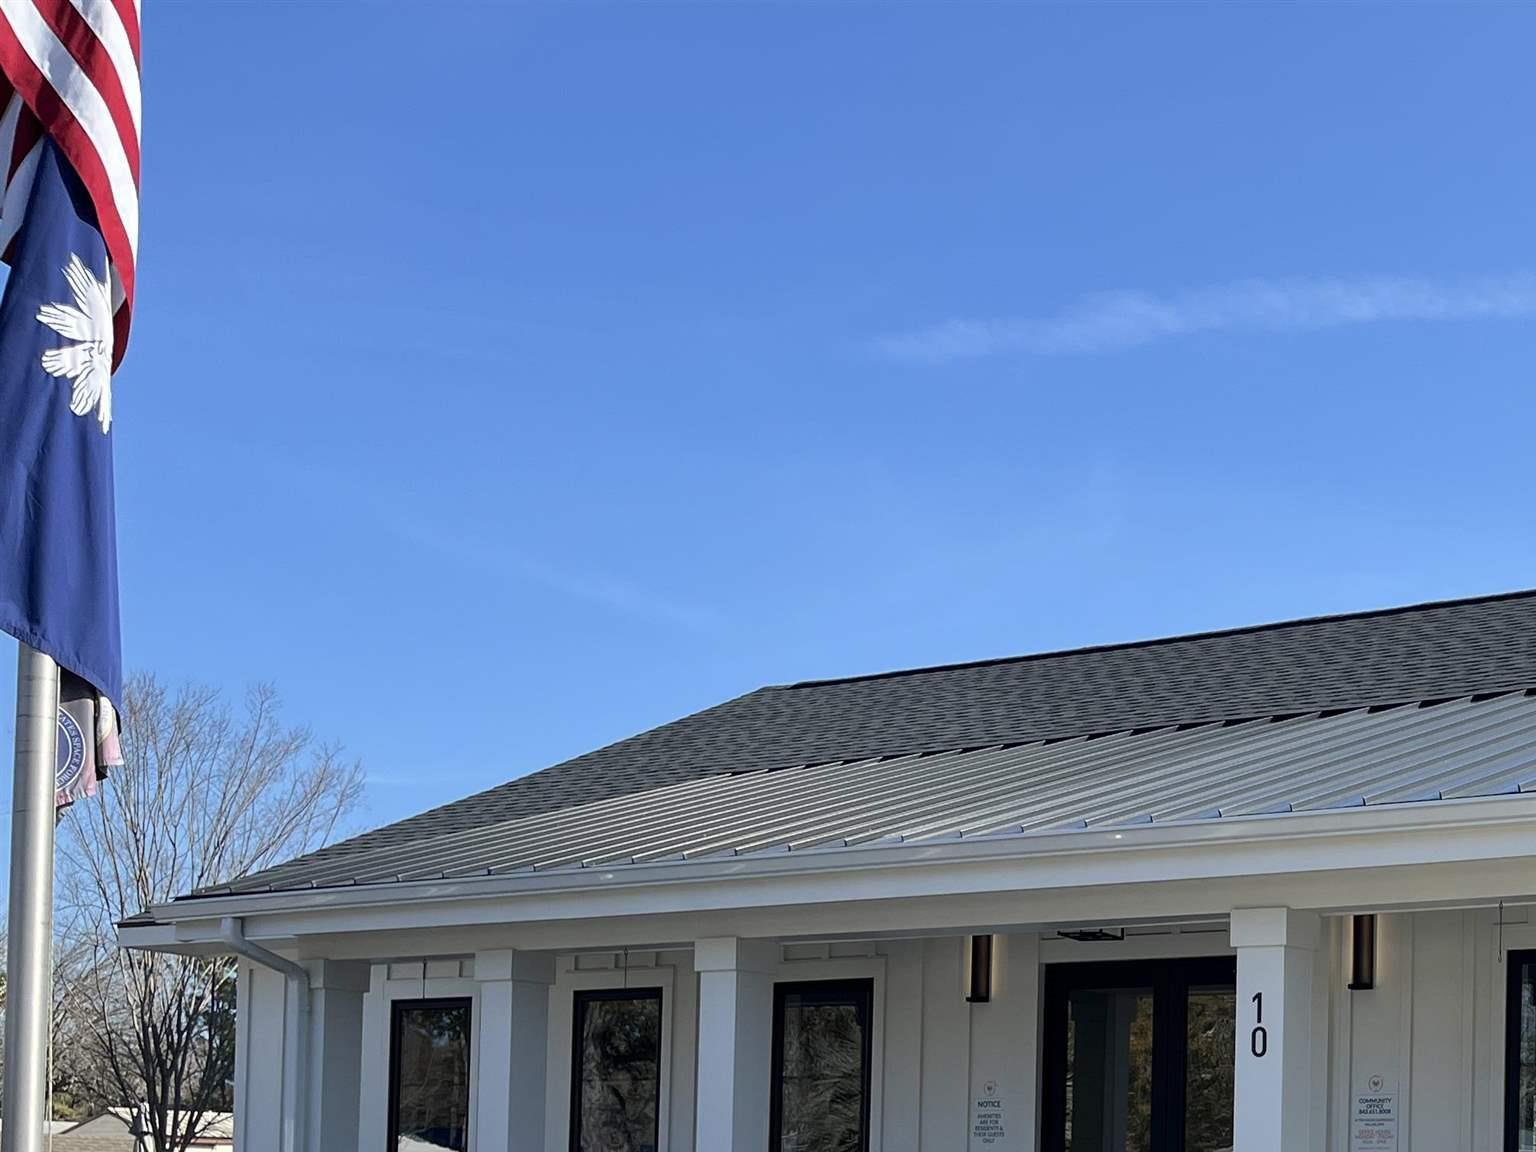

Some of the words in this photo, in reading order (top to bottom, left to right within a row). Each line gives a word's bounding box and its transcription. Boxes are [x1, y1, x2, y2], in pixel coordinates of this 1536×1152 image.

[59, 711, 77, 737] ATES
[72, 736, 81, 766] SPACE
[56, 764, 78, 787] FORC
[1251, 992, 1267, 1058] 10
[977, 1100, 1001, 1108] NOTICE
